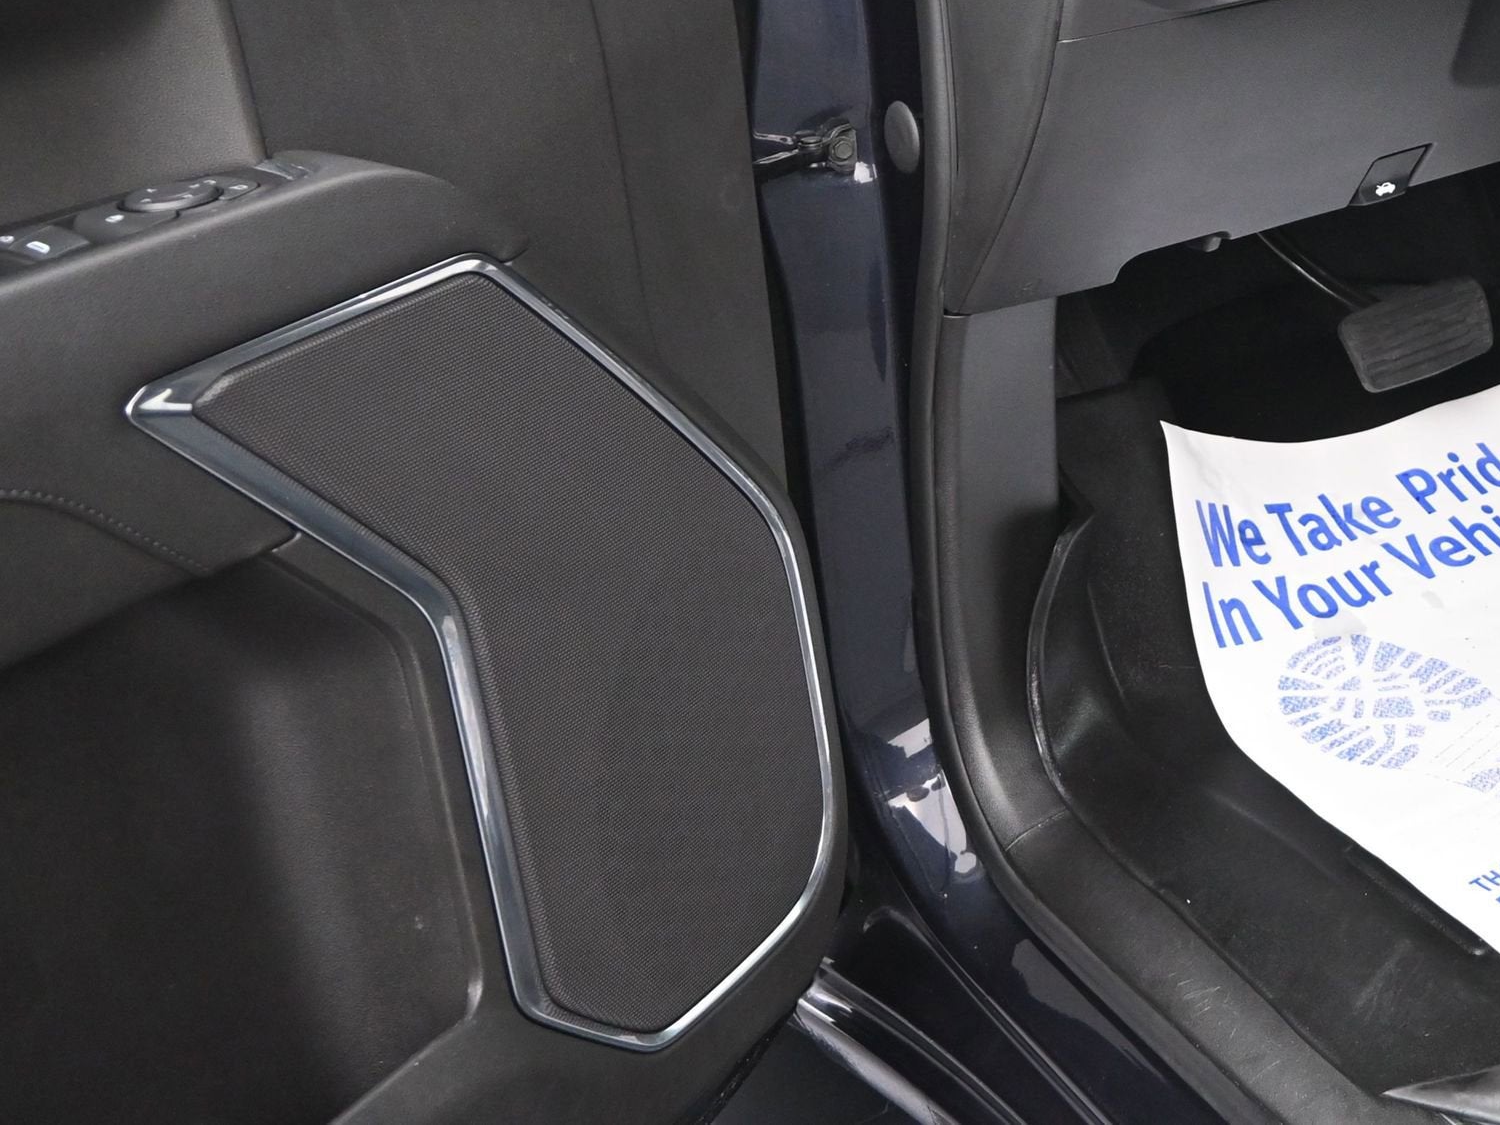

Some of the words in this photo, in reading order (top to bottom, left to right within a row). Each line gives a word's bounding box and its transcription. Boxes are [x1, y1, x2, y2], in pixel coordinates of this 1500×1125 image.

[1195, 499, 1272, 567] We
[1263, 493, 1402, 557] Take
[1202, 581, 1263, 648] In
[1251, 560, 1393, 630] Your
